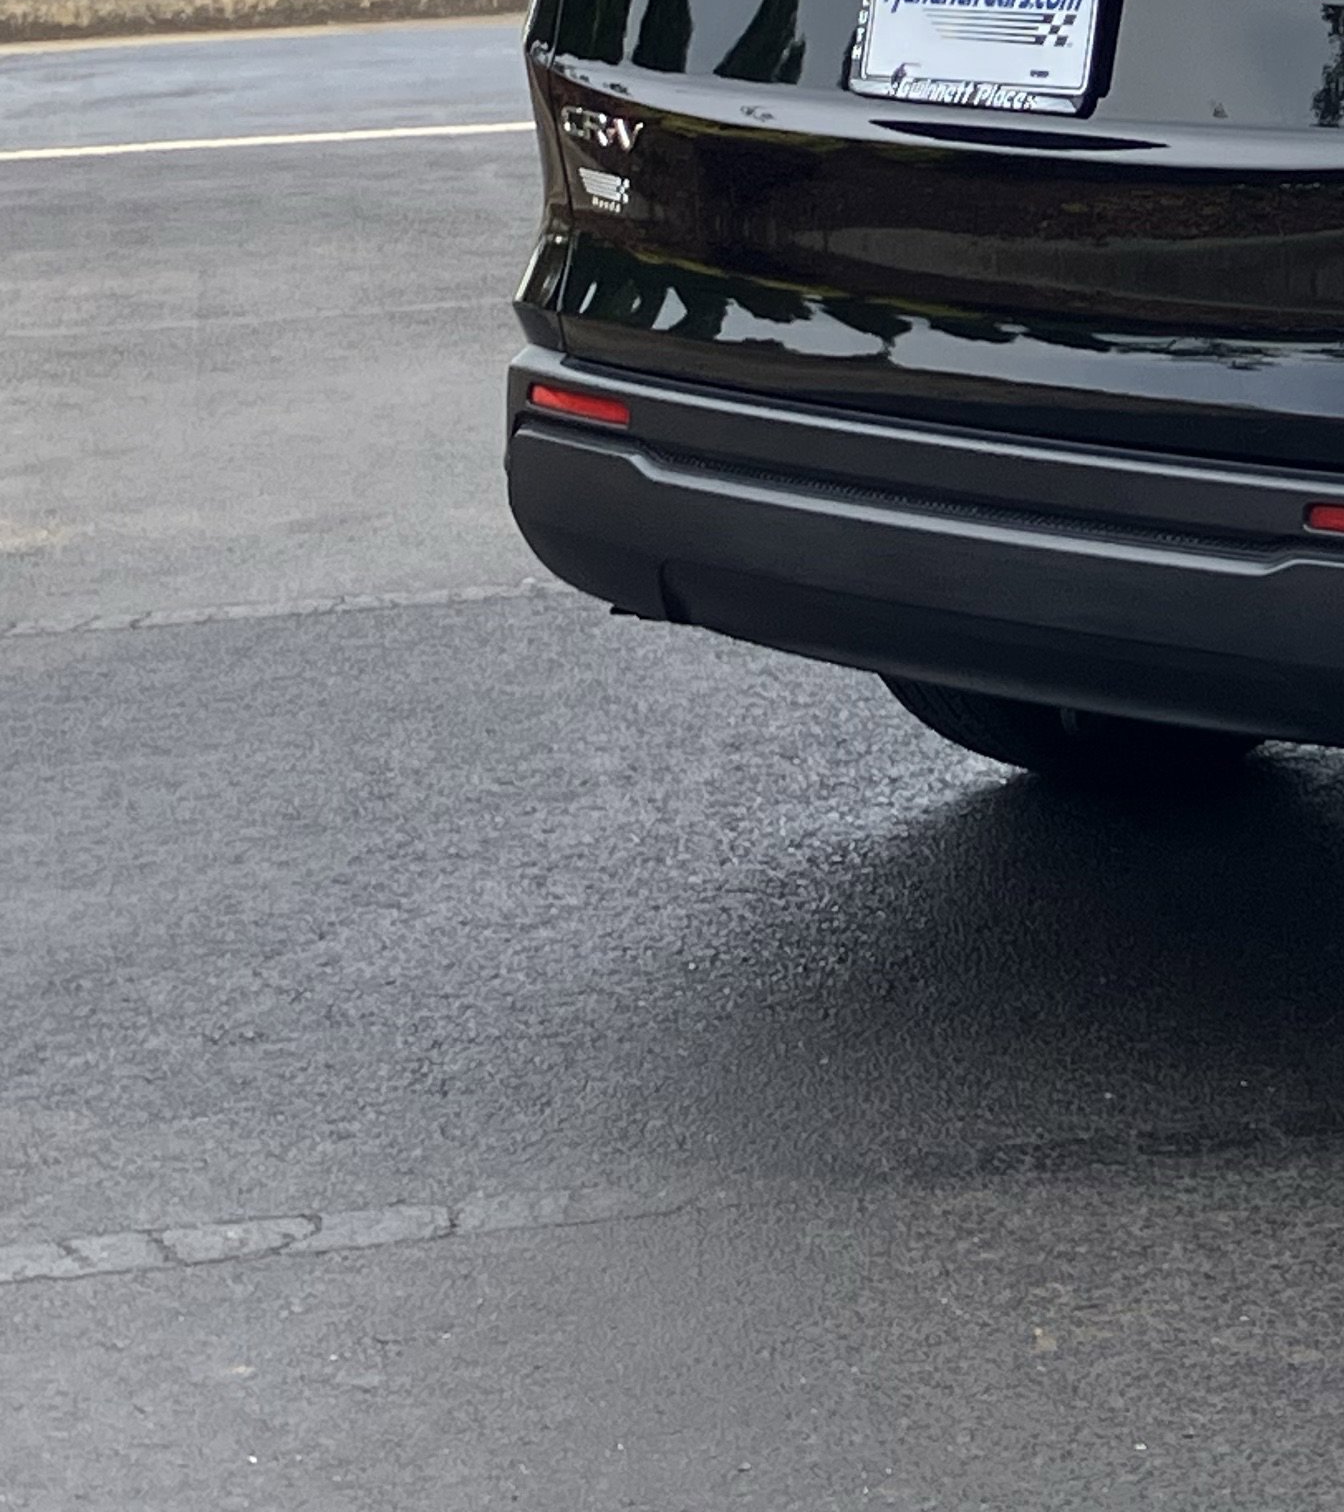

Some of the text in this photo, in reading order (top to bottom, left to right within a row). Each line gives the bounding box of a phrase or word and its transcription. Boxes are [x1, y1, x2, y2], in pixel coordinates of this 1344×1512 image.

[896, 75, 1027, 112] Gwinnett Place
[561, 106, 644, 151] CR-V
